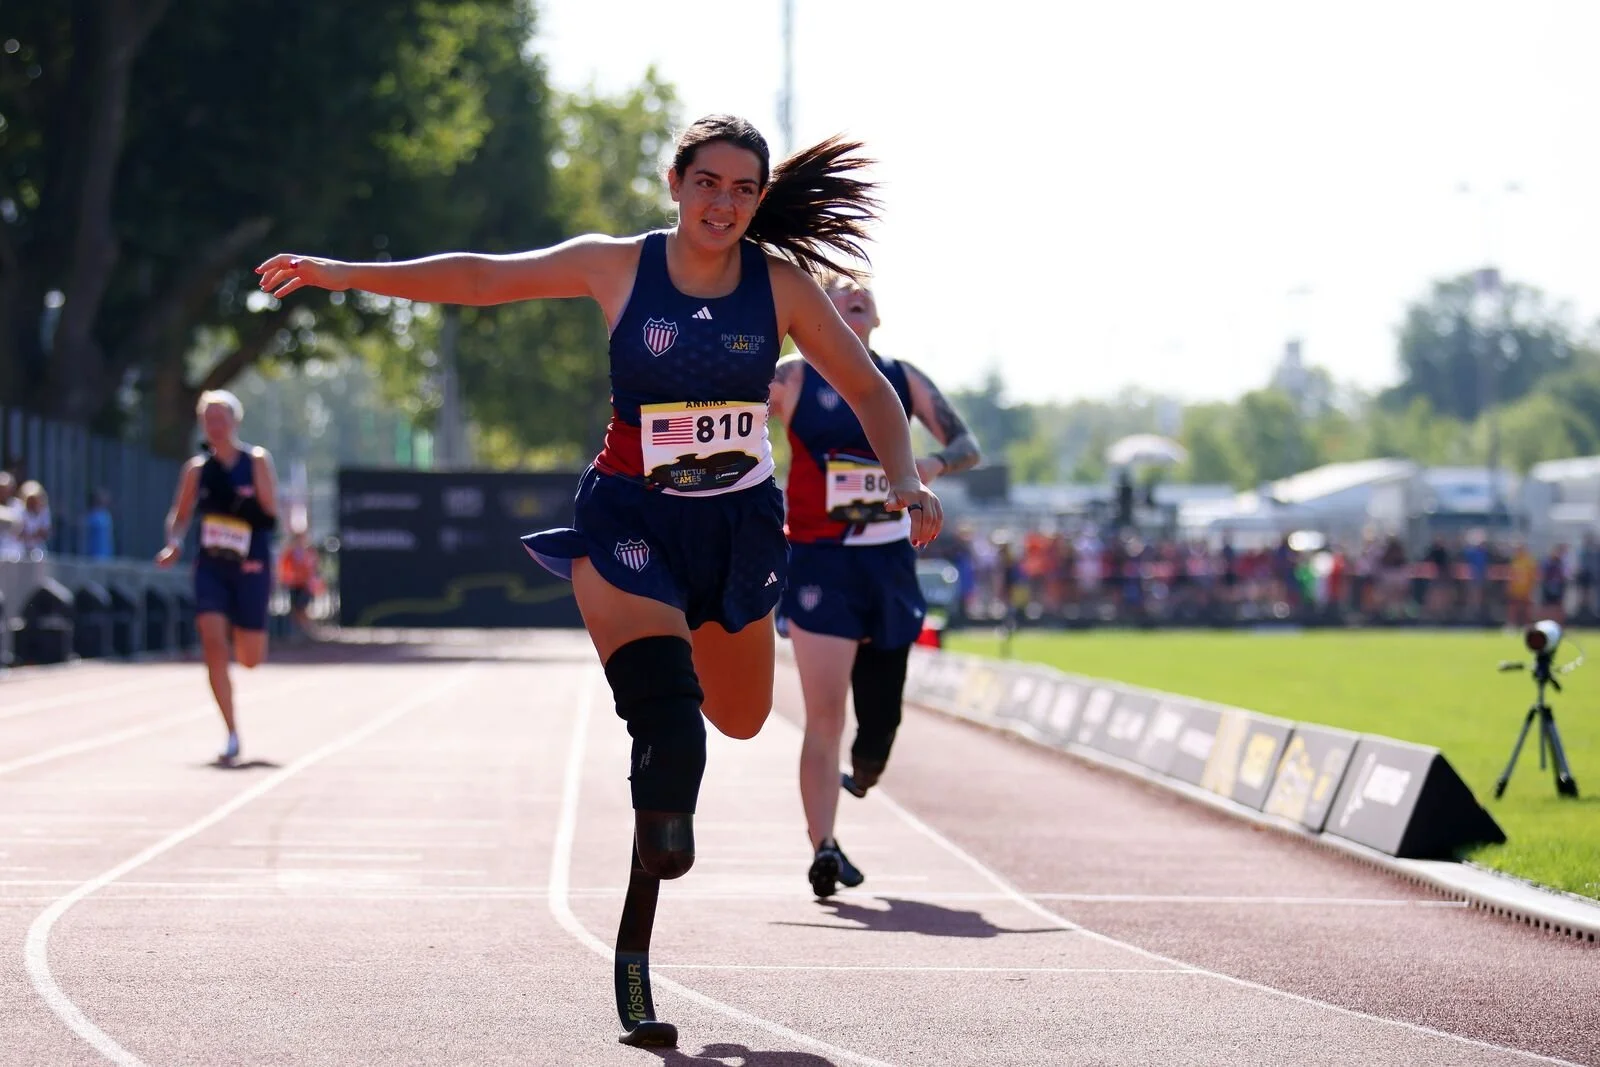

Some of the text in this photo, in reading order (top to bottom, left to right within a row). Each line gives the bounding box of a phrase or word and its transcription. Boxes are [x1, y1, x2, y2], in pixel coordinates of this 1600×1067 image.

[720, 333, 765, 343] INVICTUS
[723, 341, 760, 351] GAMES
[696, 412, 753, 442] 810
[670, 467, 707, 477] INVICTUS
[673, 475, 702, 484] GAMES
